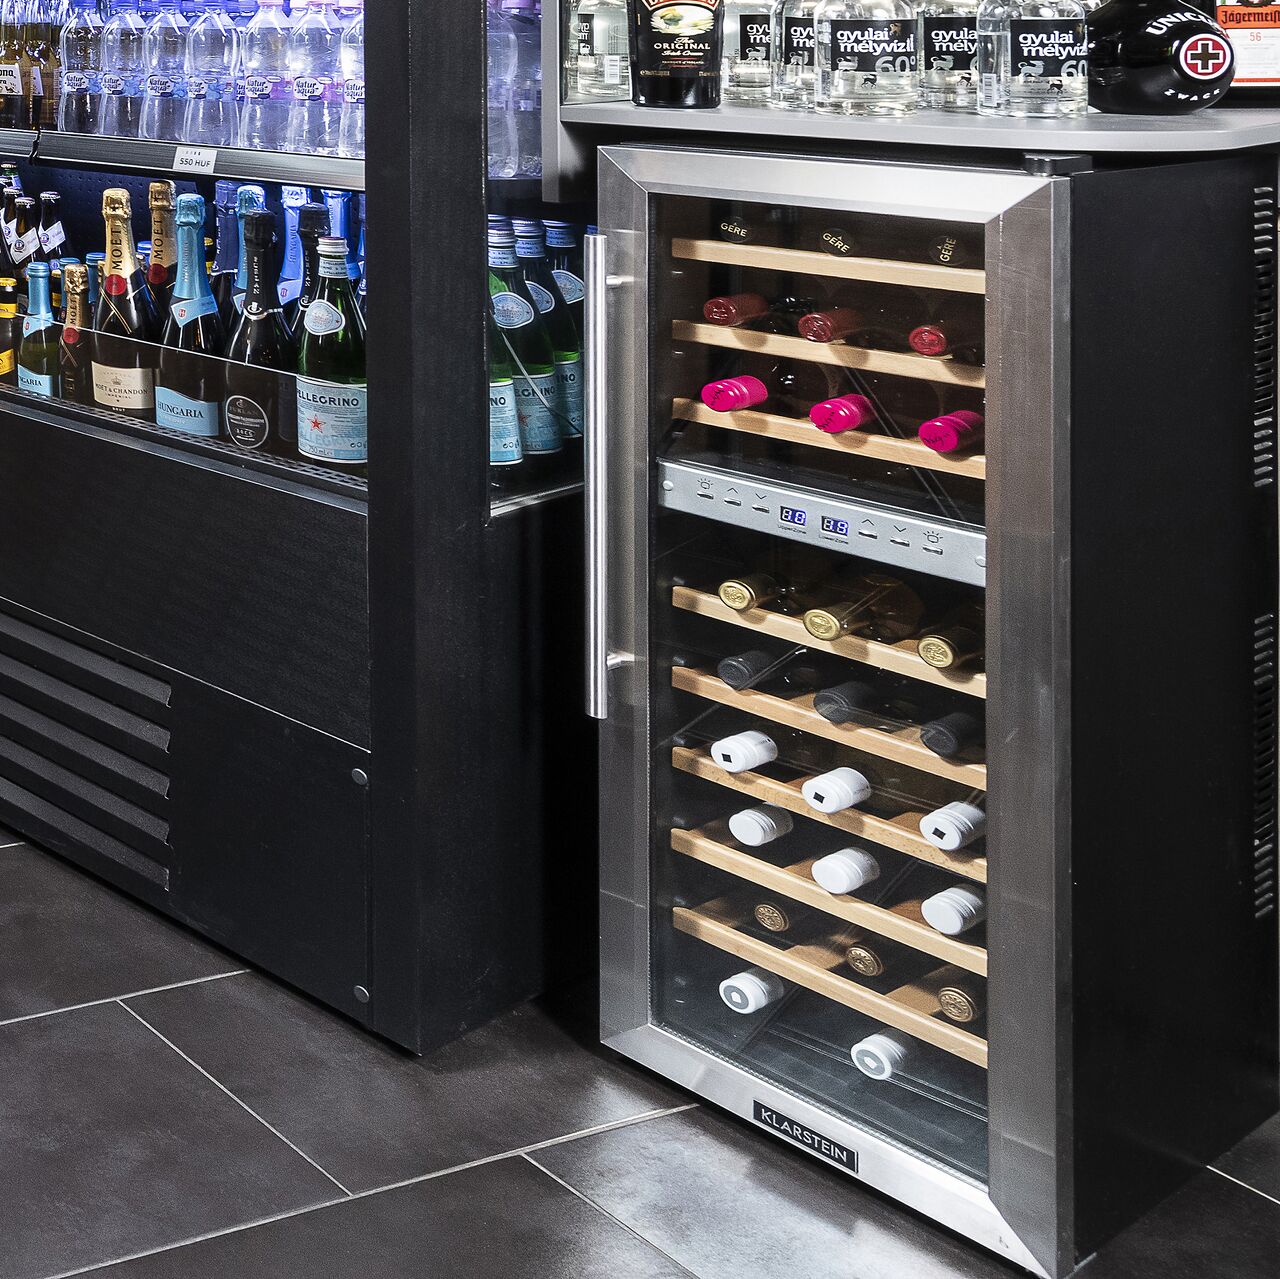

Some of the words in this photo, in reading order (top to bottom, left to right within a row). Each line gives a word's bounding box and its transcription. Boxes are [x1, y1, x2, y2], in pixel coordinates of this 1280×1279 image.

[836, 27, 889, 45] gyulai
[931, 29, 977, 45] gyula
[1018, 30, 1074, 46] gyulai
[1249, 31, 1262, 42] 56
[653, 42, 711, 50] ORIGINAL
[934, 39, 977, 56] mély
[1163, 88, 1220, 101] ZWACK
[179, 157, 194, 166] 550
[195, 158, 211, 168] HUF
[720, 222, 748, 238] GERE
[822, 231, 851, 254] GERE
[939, 236, 957, 263] GERE
[114, 385, 148, 395] CHANDON
[157, 401, 204, 419] HUNGARIA
[761, 1107, 847, 1163] KLARSTEIN
